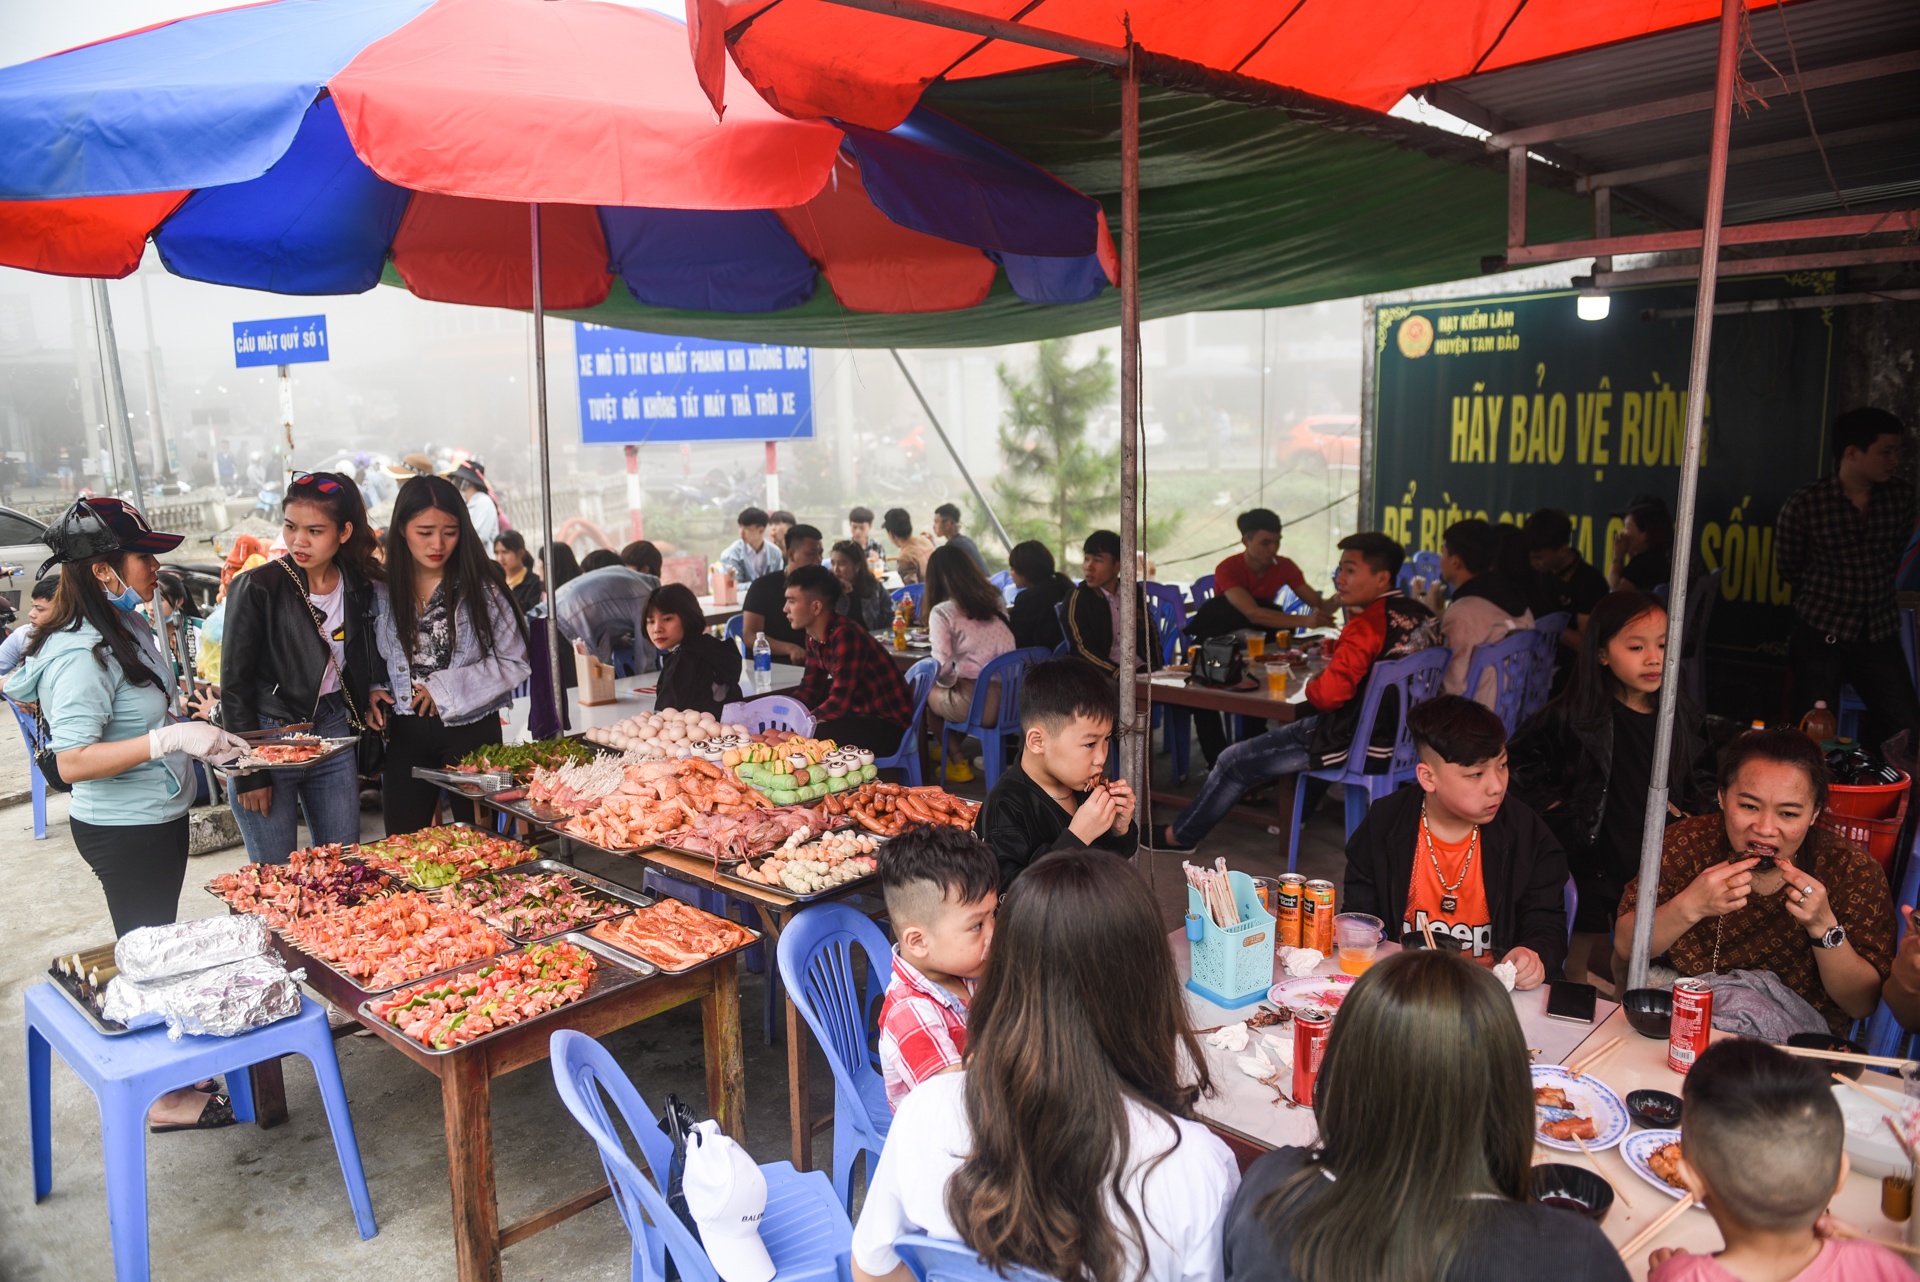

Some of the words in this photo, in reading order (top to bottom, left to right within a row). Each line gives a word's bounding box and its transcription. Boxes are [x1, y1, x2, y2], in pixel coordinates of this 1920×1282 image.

[1490, 308, 1515, 329] LÂM
[257, 330, 278, 355] MẶT
[302, 322, 317, 348] SỐ
[318, 330, 325, 347] 1
[1471, 335, 1495, 353] TAM
[579, 353, 594, 377] XE
[628, 351, 648, 376] TAY
[649, 351, 665, 375] GA
[690, 348, 726, 374] PHANH
[727, 347, 745, 372] KHI
[642, 390, 678, 419] KHÔNG
[781, 391, 796, 415] XE
[1451, 380, 1504, 463] HÃY
[1508, 361, 1567, 464] BẢO
[1576, 375, 1612, 482] VỆ
[1619, 371, 1711, 467] RỪN
